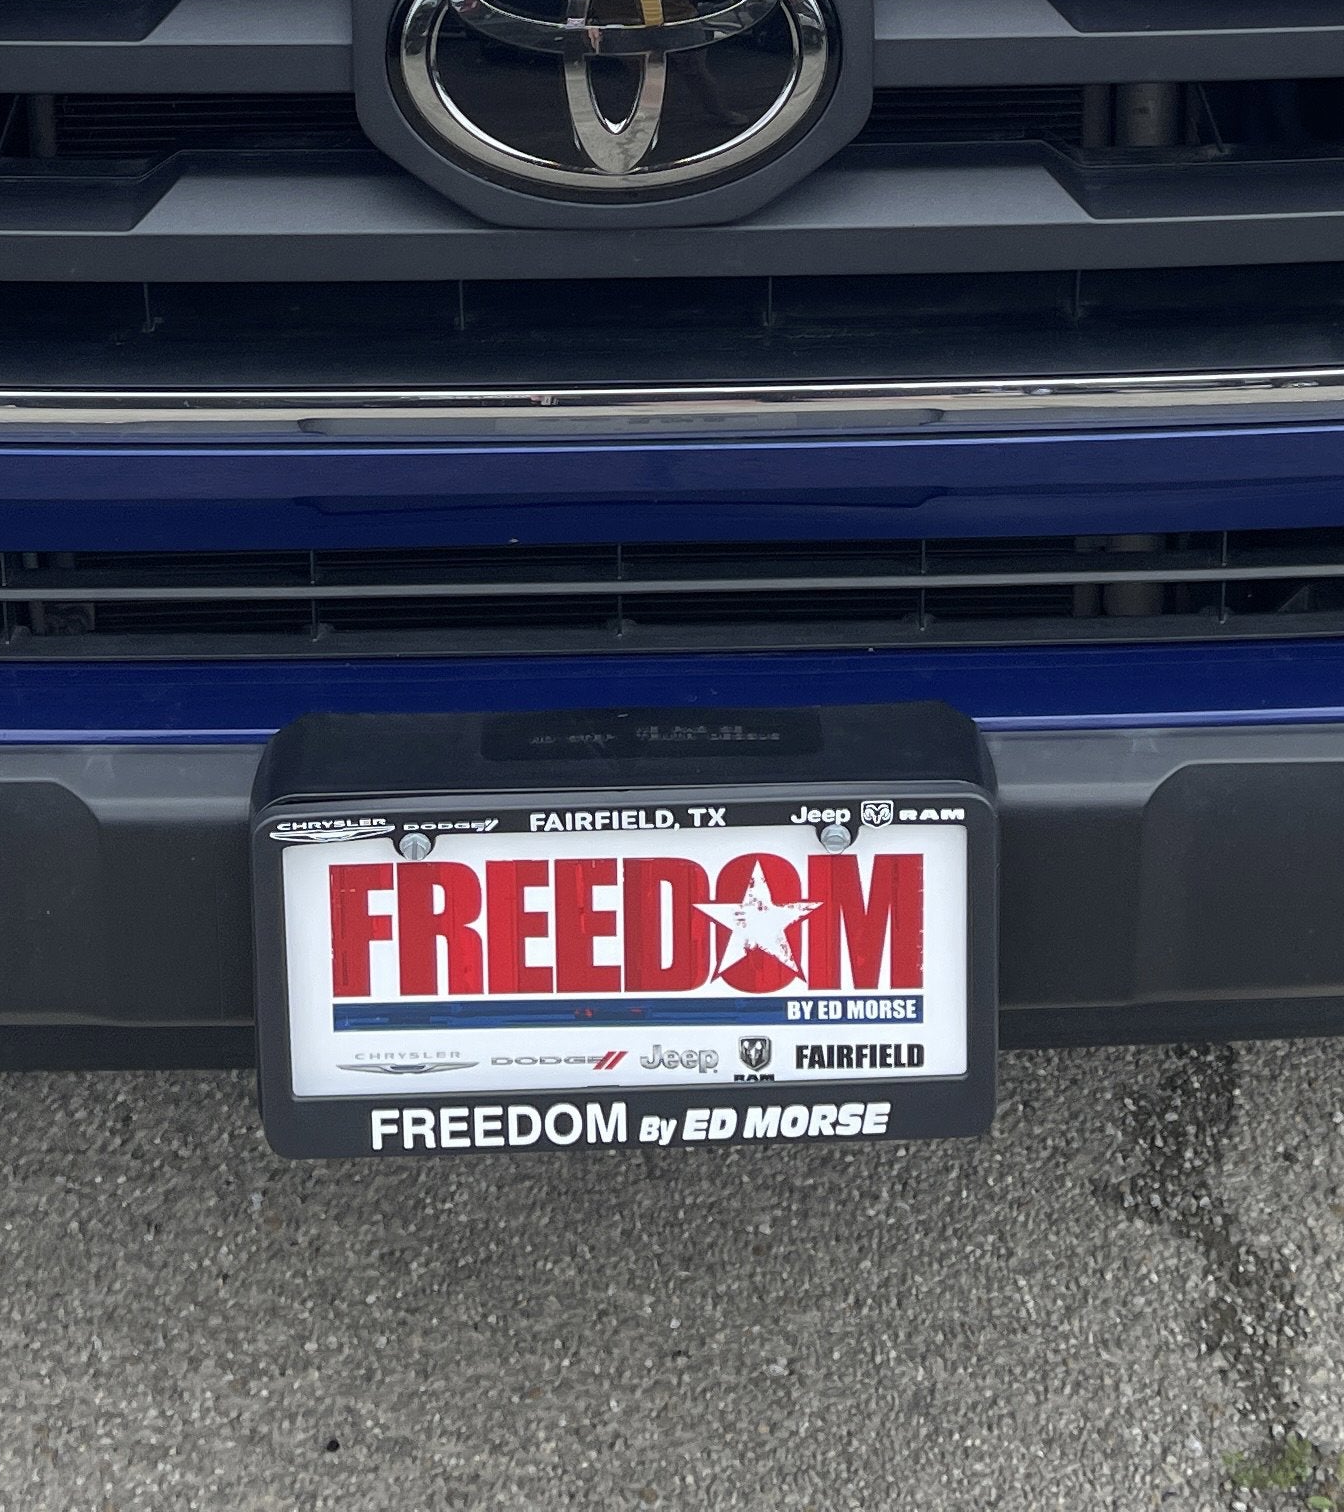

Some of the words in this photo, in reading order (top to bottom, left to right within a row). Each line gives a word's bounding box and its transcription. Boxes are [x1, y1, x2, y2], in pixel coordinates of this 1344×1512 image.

[276, 818, 387, 831] CHRYSLER
[529, 809, 680, 831] FAIRFIELD,
[687, 807, 727, 827] TX
[790, 806, 851, 825] Jeep
[898, 808, 965, 822] RAM
[328, 852, 925, 997] FREEDOM
[786, 1000, 814, 1021] BY
[817, 1000, 842, 1020] ED
[846, 999, 917, 1020] MORSE
[354, 1051, 462, 1061] CHRYSLER
[639, 1044, 720, 1074] Jeep
[795, 1043, 925, 1070] FAIRFIELD
[370, 1101, 628, 1150] FREEDOM
[638, 1115, 677, 1145] By
[682, 1107, 735, 1141] ED
[742, 1102, 892, 1138] MORSE
